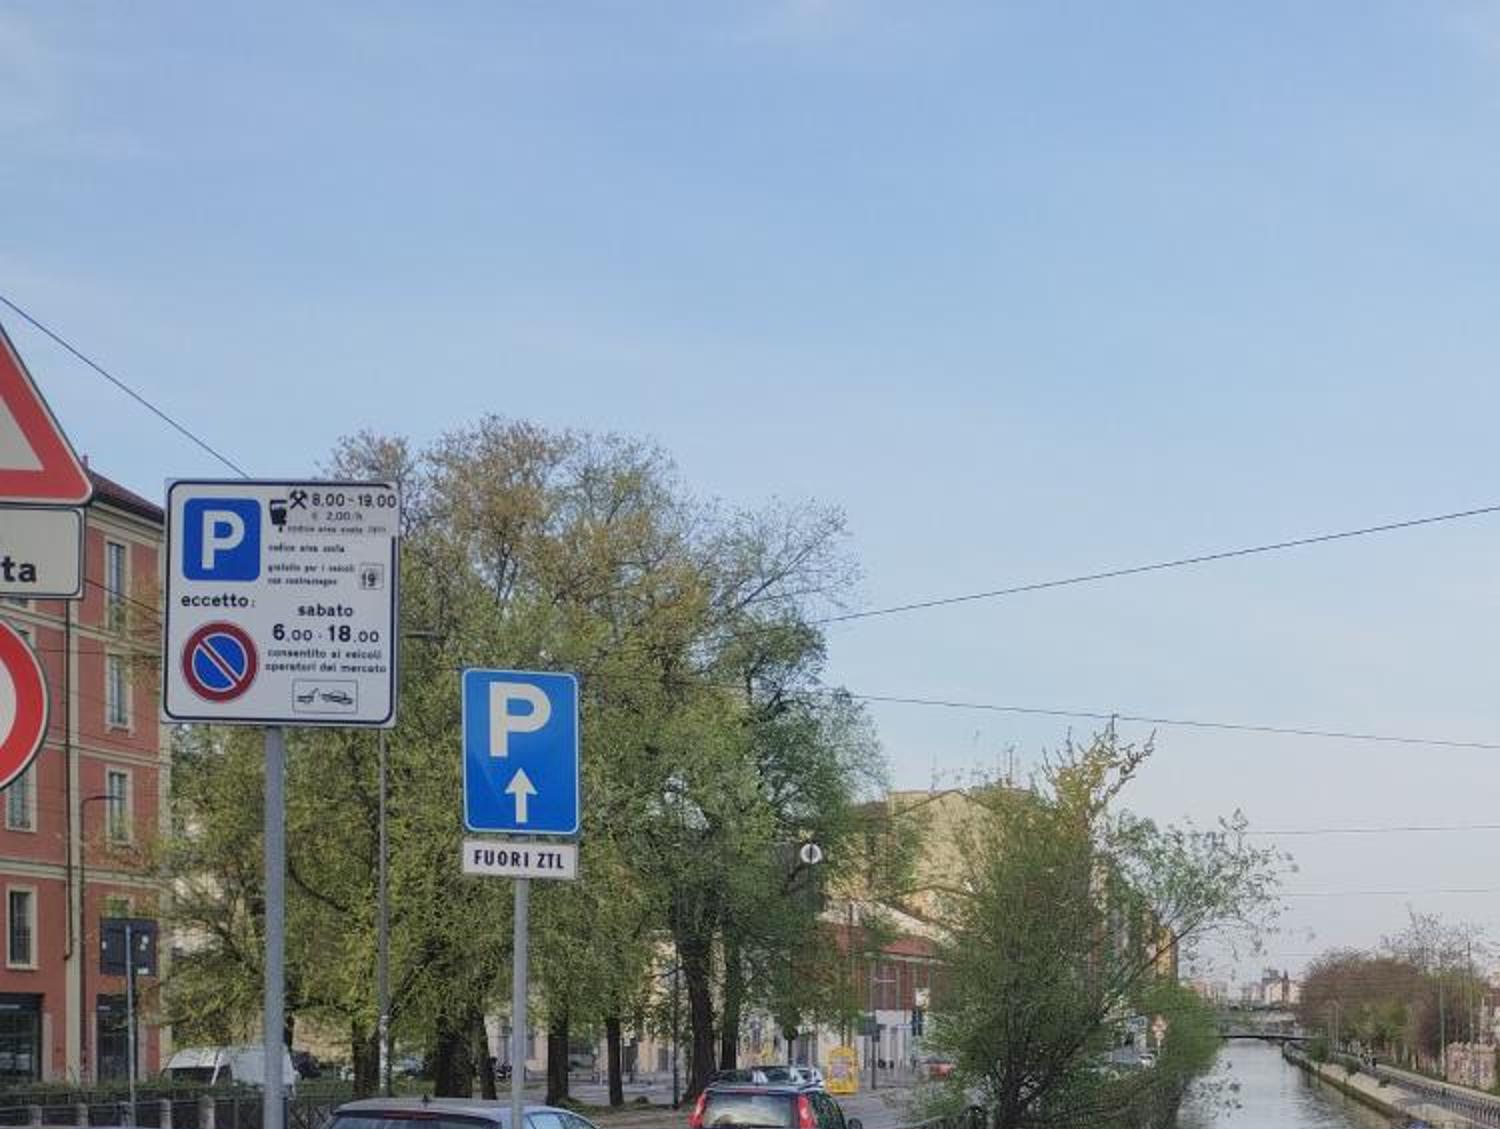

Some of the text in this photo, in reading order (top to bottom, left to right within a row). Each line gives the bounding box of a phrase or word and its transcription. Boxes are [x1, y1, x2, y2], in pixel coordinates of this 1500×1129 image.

[201, 510, 245, 571] P
[297, 603, 353, 617] sabato
[267, 649, 327, 659] consentito
[341, 665, 387, 674] mercato
[489, 681, 552, 758] P
[474, 849, 565, 870] FUORI ZTL
